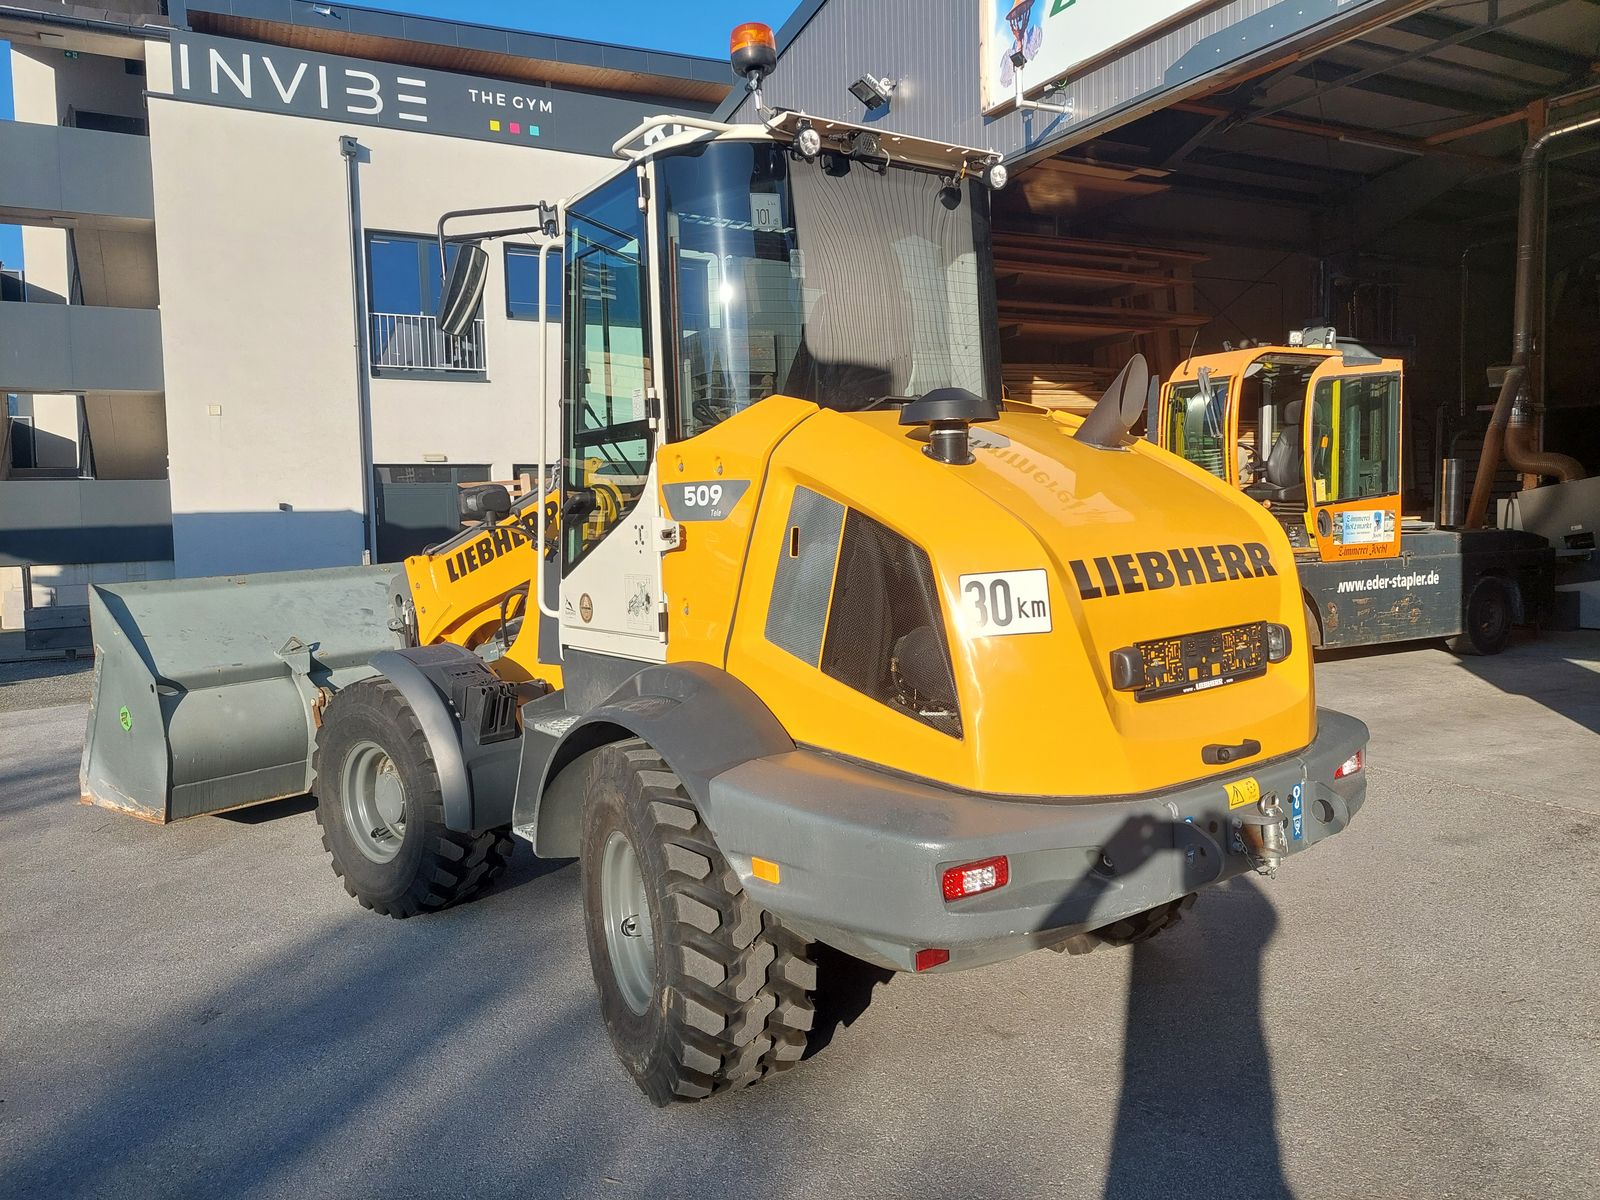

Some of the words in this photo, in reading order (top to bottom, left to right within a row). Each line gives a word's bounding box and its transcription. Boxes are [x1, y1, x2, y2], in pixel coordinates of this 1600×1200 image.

[180, 43, 428, 122] INVIBE
[468, 89, 506, 106] THE
[512, 96, 553, 113] GYM
[756, 208, 770, 225] 101
[684, 484, 723, 507] 509
[1069, 542, 1279, 600] LIEBHERR
[1337, 570, 1440, 594] www.eder-stapler.de
[964, 578, 1013, 628] 30
[1017, 597, 1047, 619] km
